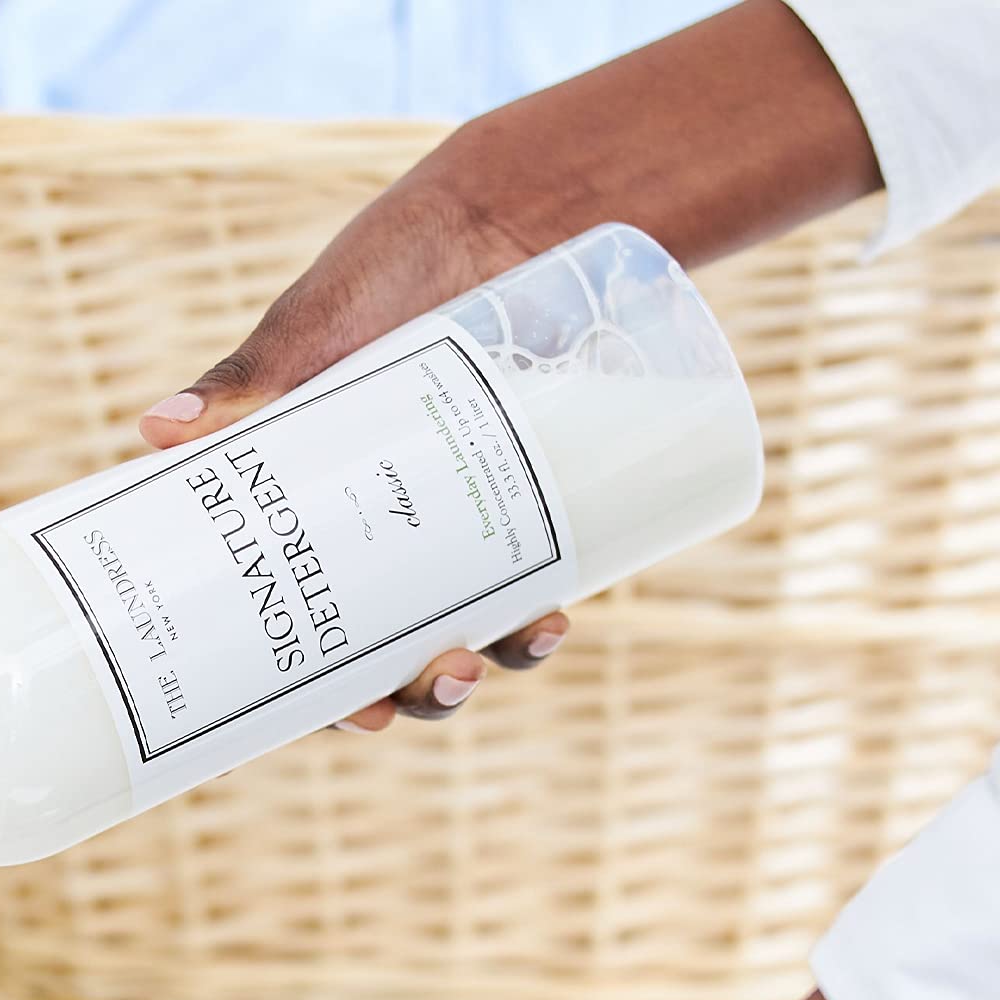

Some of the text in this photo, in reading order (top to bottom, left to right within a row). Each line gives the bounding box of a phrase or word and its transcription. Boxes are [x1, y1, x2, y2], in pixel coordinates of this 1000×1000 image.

[468, 398, 485, 424] liter
[478, 421, 489, 430] 1
[419, 362, 523, 564] Highly Concentrated Up to 64 washes
[420, 393, 496, 541] Everyday Laundering
[493, 440, 504, 457] oz.
[497, 458, 511, 474] fl.
[376, 459, 421, 528] classic
[503, 474, 522, 500] 33.3
[186, 467, 305, 672] SIGNATURE
[225, 447, 349, 656] DETERGENT
[84, 529, 187, 719] THE LAUNDRESS
[144, 580, 178, 641] NEW YORK
